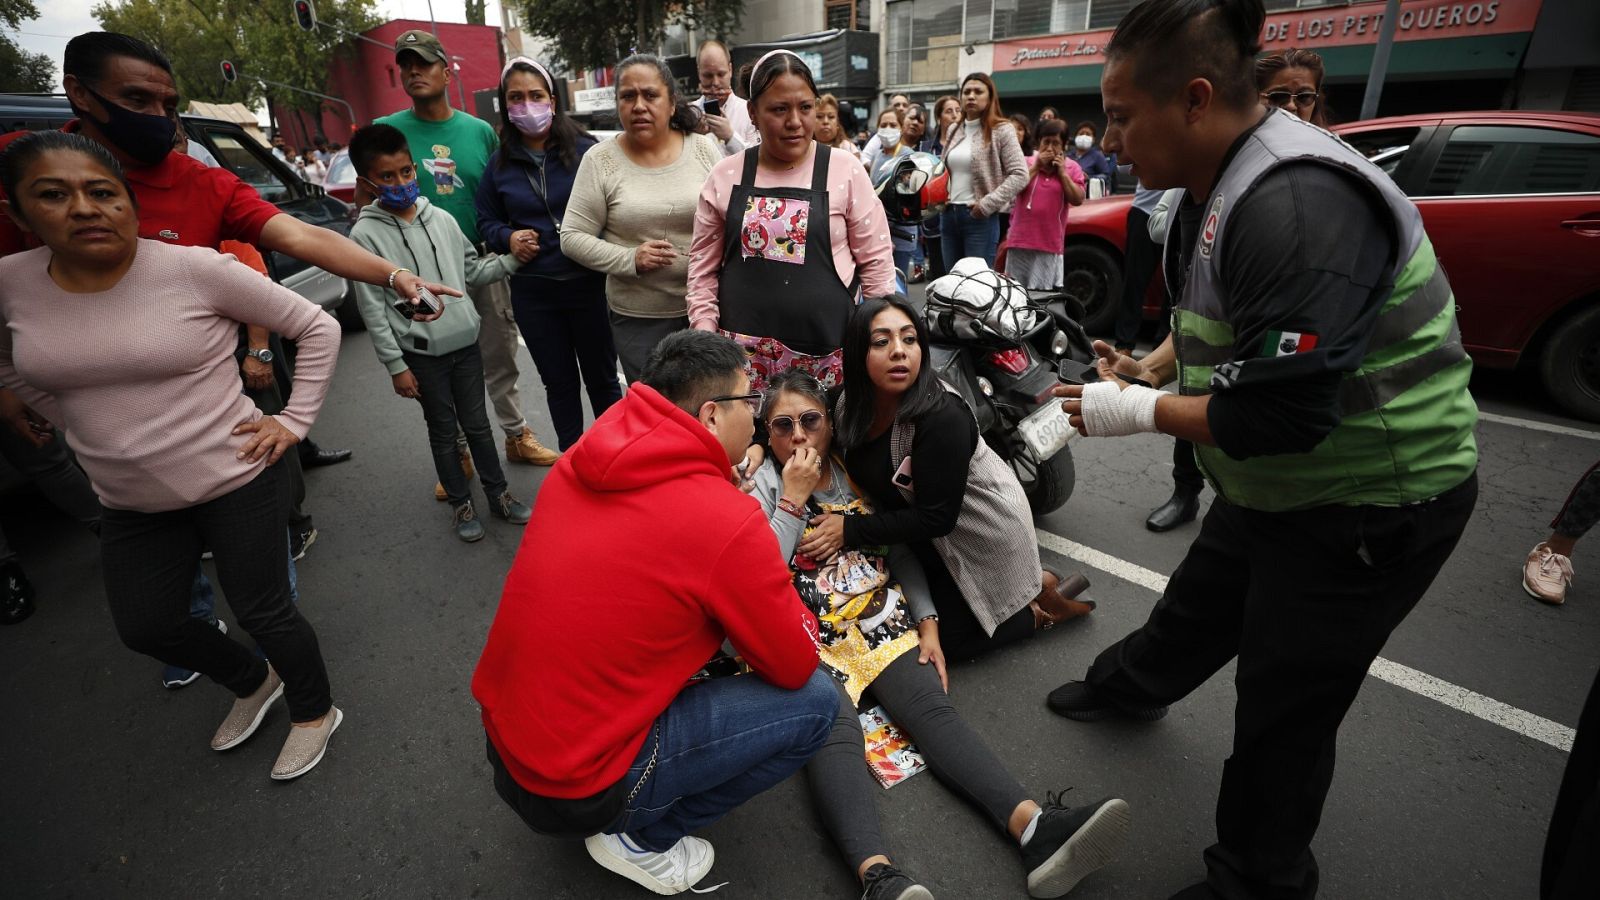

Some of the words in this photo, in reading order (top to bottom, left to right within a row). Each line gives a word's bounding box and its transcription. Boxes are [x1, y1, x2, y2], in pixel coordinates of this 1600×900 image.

[1265, 23, 1289, 41] DE
[1297, 18, 1334, 39] LOS
[1343, 2, 1498, 35] PETQUEROS
